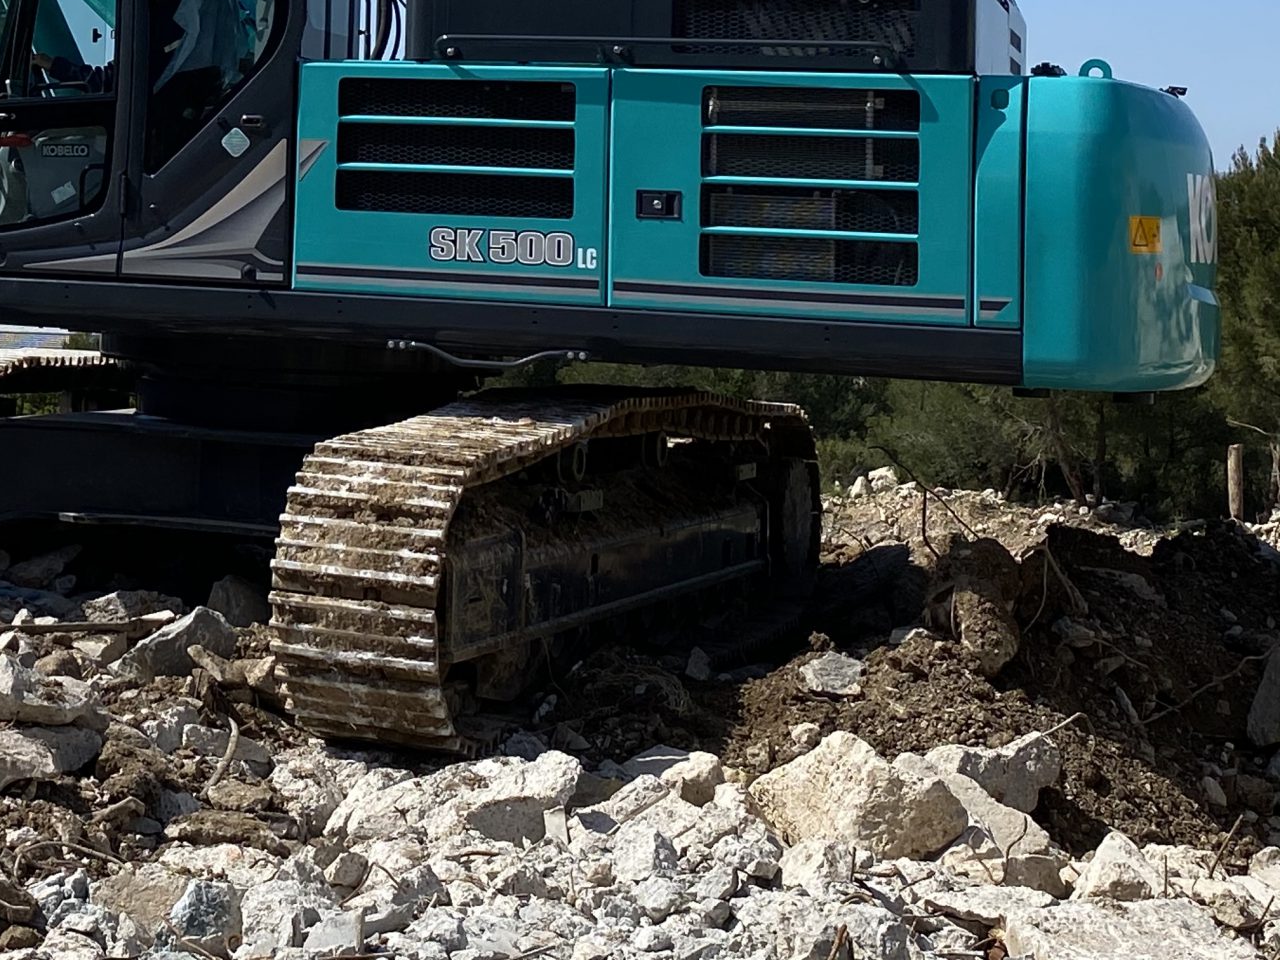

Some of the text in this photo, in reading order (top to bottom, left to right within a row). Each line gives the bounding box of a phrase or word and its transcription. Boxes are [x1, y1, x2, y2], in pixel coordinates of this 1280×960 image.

[42, 144, 88, 156] KOBELCO
[1187, 173, 1218, 264] KO
[429, 226, 597, 269] SK 500 LC
